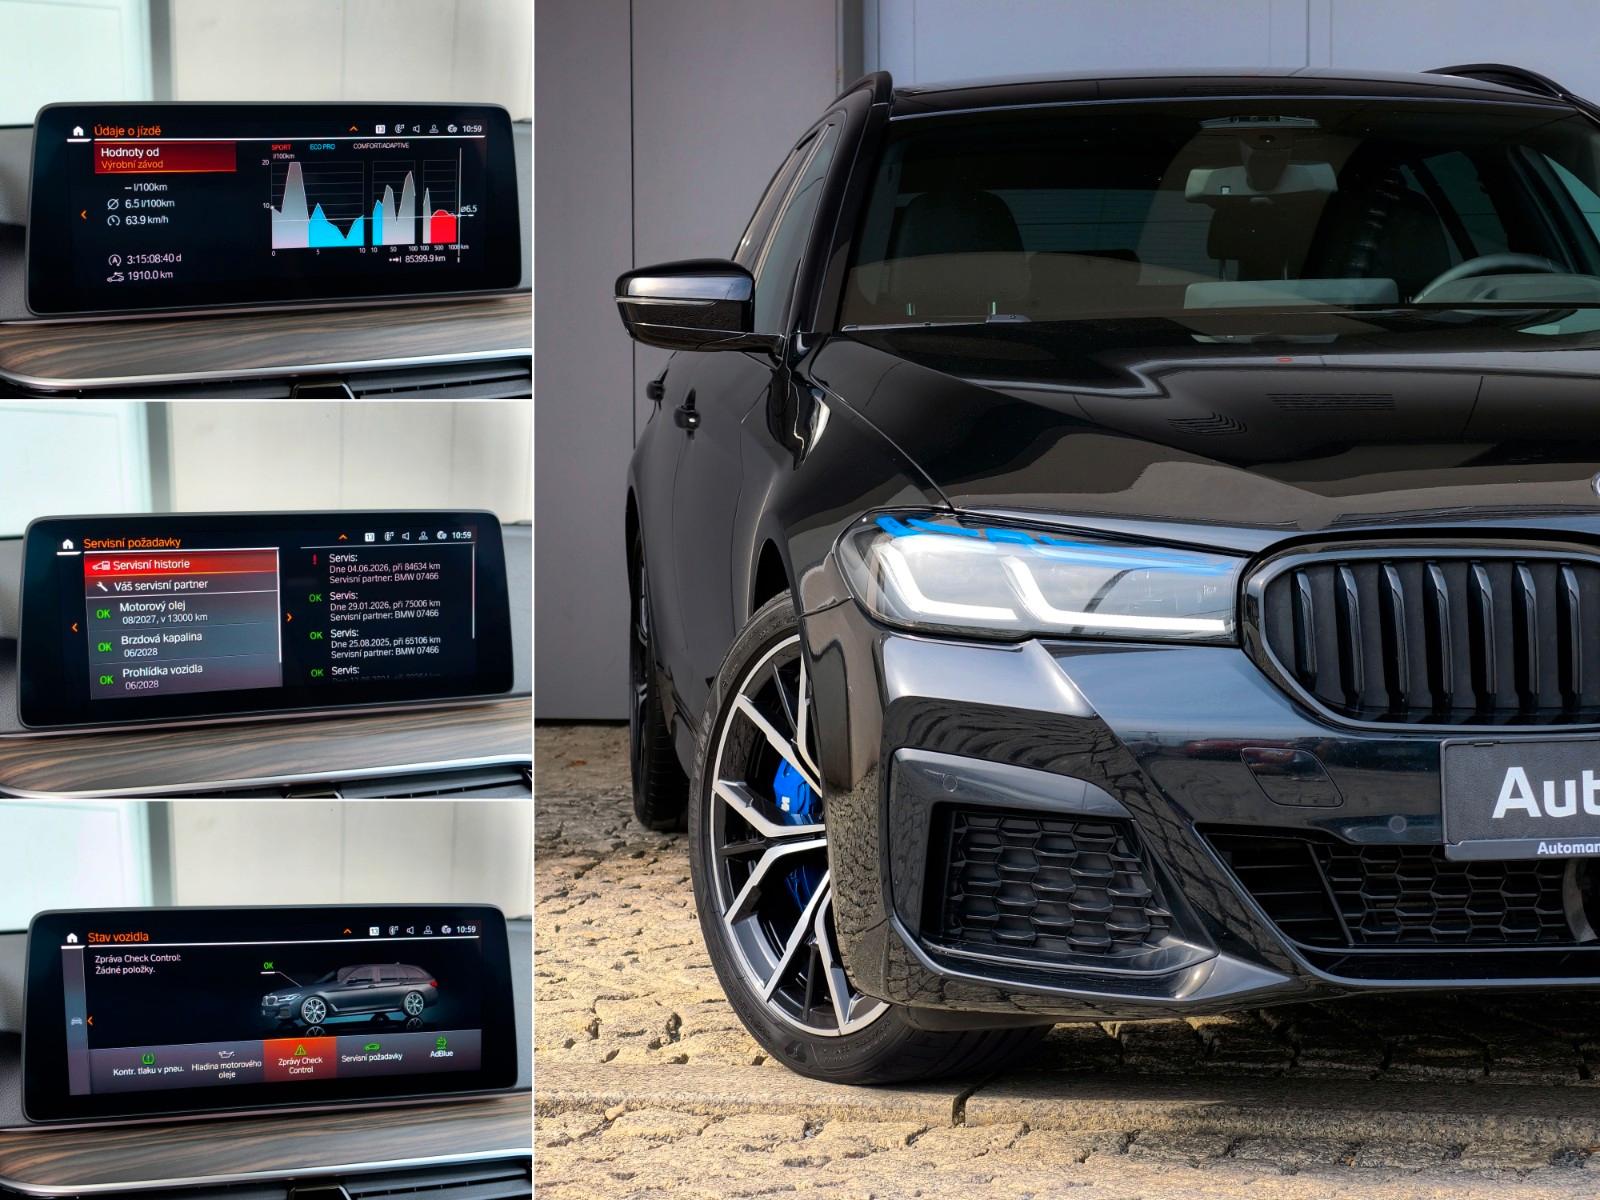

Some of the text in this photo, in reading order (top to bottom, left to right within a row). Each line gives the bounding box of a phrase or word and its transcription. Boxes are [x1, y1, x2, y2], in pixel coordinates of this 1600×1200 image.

[94, 124, 125, 137] Údaje
[137, 125, 162, 137] jízdě
[462, 125, 482, 133] 10:59
[101, 148, 159, 158] Hodnoty od
[102, 160, 163, 170] Výrobní závod
[134, 183, 167, 192] l/100km
[126, 200, 175, 208] 6.5 l/100km
[126, 216, 168, 225] 63.9 km/h
[127, 254, 174, 264] 3:15:08:40
[128, 270, 173, 280] 1910.0 km
[84, 538, 181, 549] Servisní požadavky
[329, 554, 358, 563] Servis:
[113, 560, 190, 570] Servisní historie
[330, 565, 345, 574] Dne
[348, 564, 390, 573] 04.06.2026,
[393, 563, 403, 572] při
[330, 575, 360, 584] Servisní
[362, 574, 392, 583] partner:
[115, 580, 208, 591] Váš servisní partner
[330, 592, 358, 600] Servis:
[120, 601, 185, 613] Motorový olej
[330, 603, 346, 611] Dne
[348, 602, 390, 610] 29.01.2026,
[392, 600, 403, 609] při
[96, 610, 110, 618] OK
[330, 613, 361, 622] Servisní
[363, 611, 393, 620] partner:
[123, 615, 158, 624] 08/2027,
[121, 632, 202, 645] Brzdová kapalina
[330, 629, 358, 638] Servis:
[393, 638, 403, 646] při
[98, 643, 112, 652] OK
[124, 648, 158, 657] 06/2028
[331, 650, 362, 659] Servisní
[364, 649, 393, 658] partner:
[123, 664, 202, 678] Prohlídka vozidla
[332, 666, 359, 675] Servis:
[100, 676, 113, 684] OK
[126, 680, 159, 690] 06/2028
[1492, 767, 1600, 818] Aut
[88, 932, 149, 942] Stav vozidla
[96, 956, 122, 964] Zpráva
[96, 964, 155, 975] Žádné položky.
[279, 1056, 323, 1067] Zprávy Check
[342, 1053, 402, 1062] Servisní požadavky
[138, 1067, 156, 1075] tlaku
[164, 1066, 184, 1074] pneu.
[192, 1060, 262, 1071] Hladina motorového
[289, 1066, 314, 1074] Control
[219, 1071, 235, 1079] oleje
